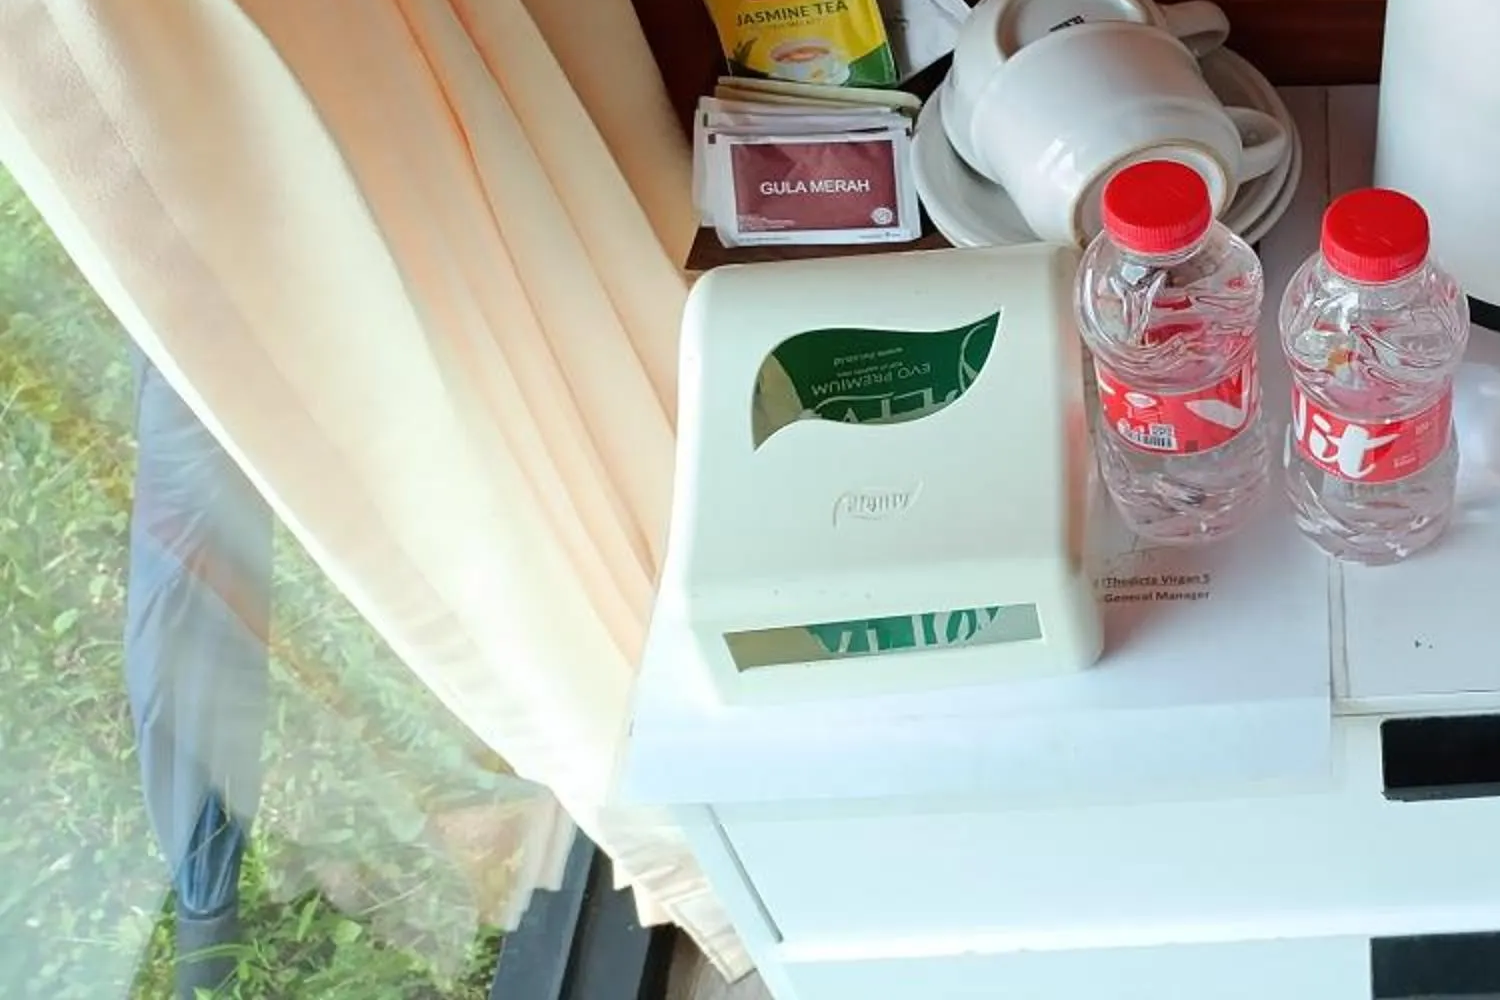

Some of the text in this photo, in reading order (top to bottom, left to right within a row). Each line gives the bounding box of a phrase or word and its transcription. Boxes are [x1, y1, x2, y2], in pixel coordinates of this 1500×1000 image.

[736, 5, 809, 27] JASMINE
[812, 0, 849, 15] TEA
[760, 178, 870, 195] GULA MERAH
[897, 362, 931, 378] EVO
[811, 370, 893, 397] PREMIUM
[1104, 591, 1210, 603] General Manager
